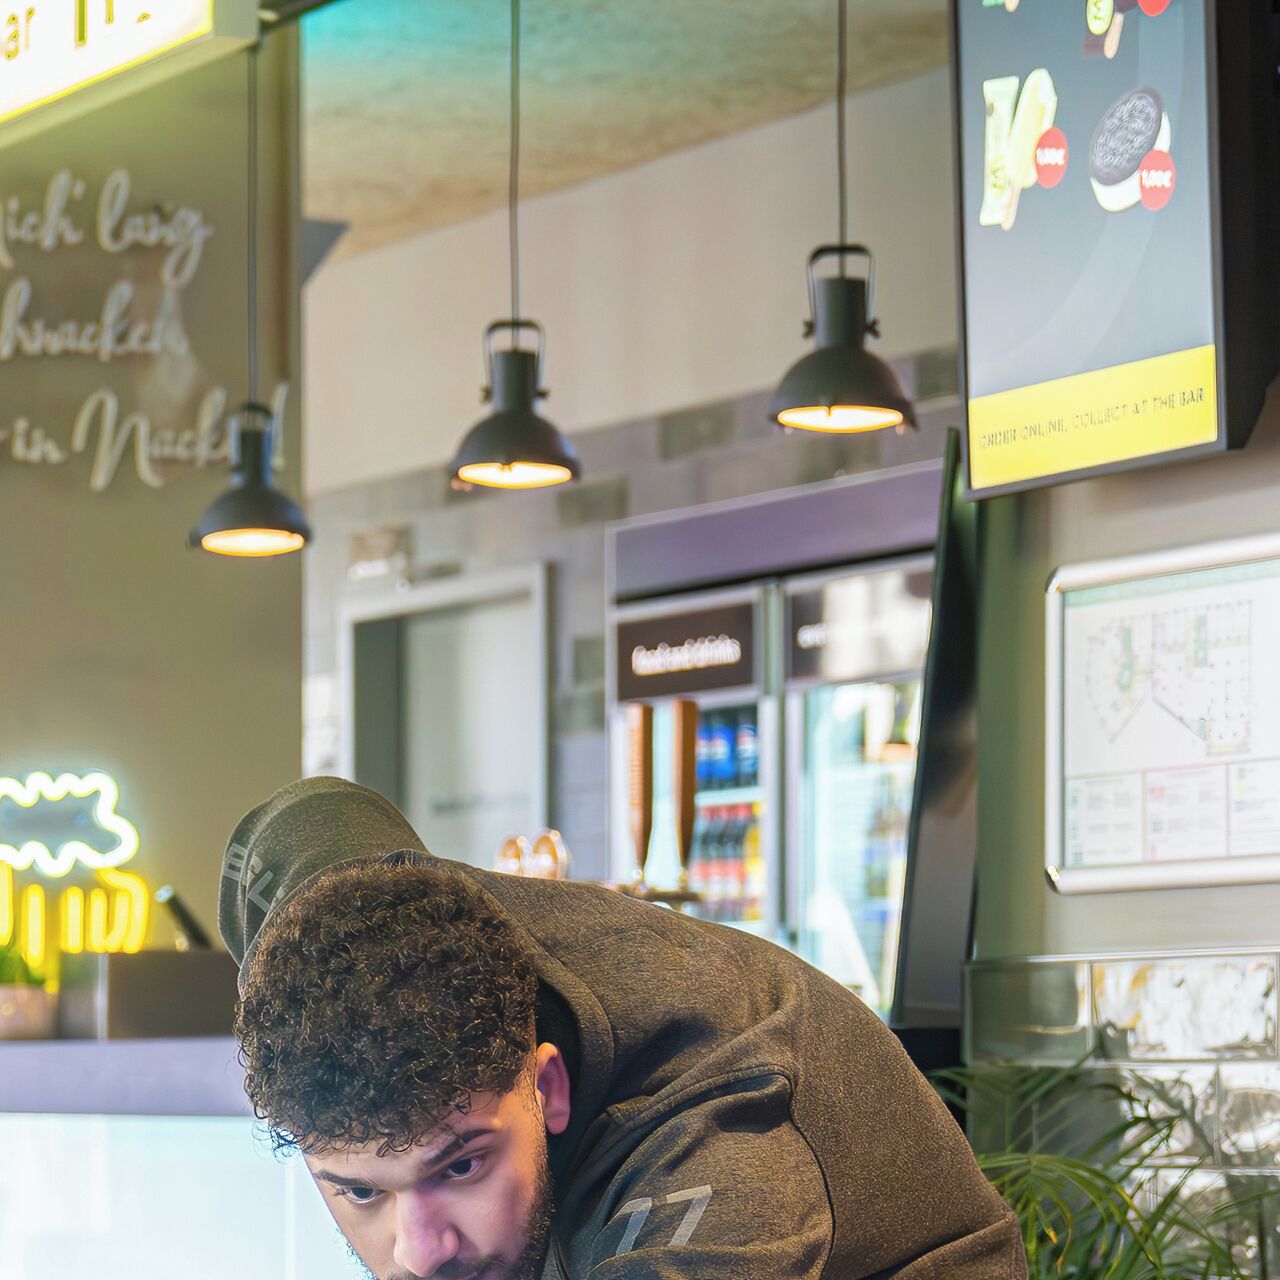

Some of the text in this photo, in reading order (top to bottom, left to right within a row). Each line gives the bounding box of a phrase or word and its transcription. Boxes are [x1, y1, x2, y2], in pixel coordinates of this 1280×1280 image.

[97, 168, 214, 289] lang
[11, 416, 66, 465] in
[979, 428, 1017, 449] ORDER
[1073, 404, 1128, 429] COLLECT
[1132, 398, 1149, 415] AT
[1152, 393, 1176, 410] THE
[1179, 387, 1205, 407] BAR
